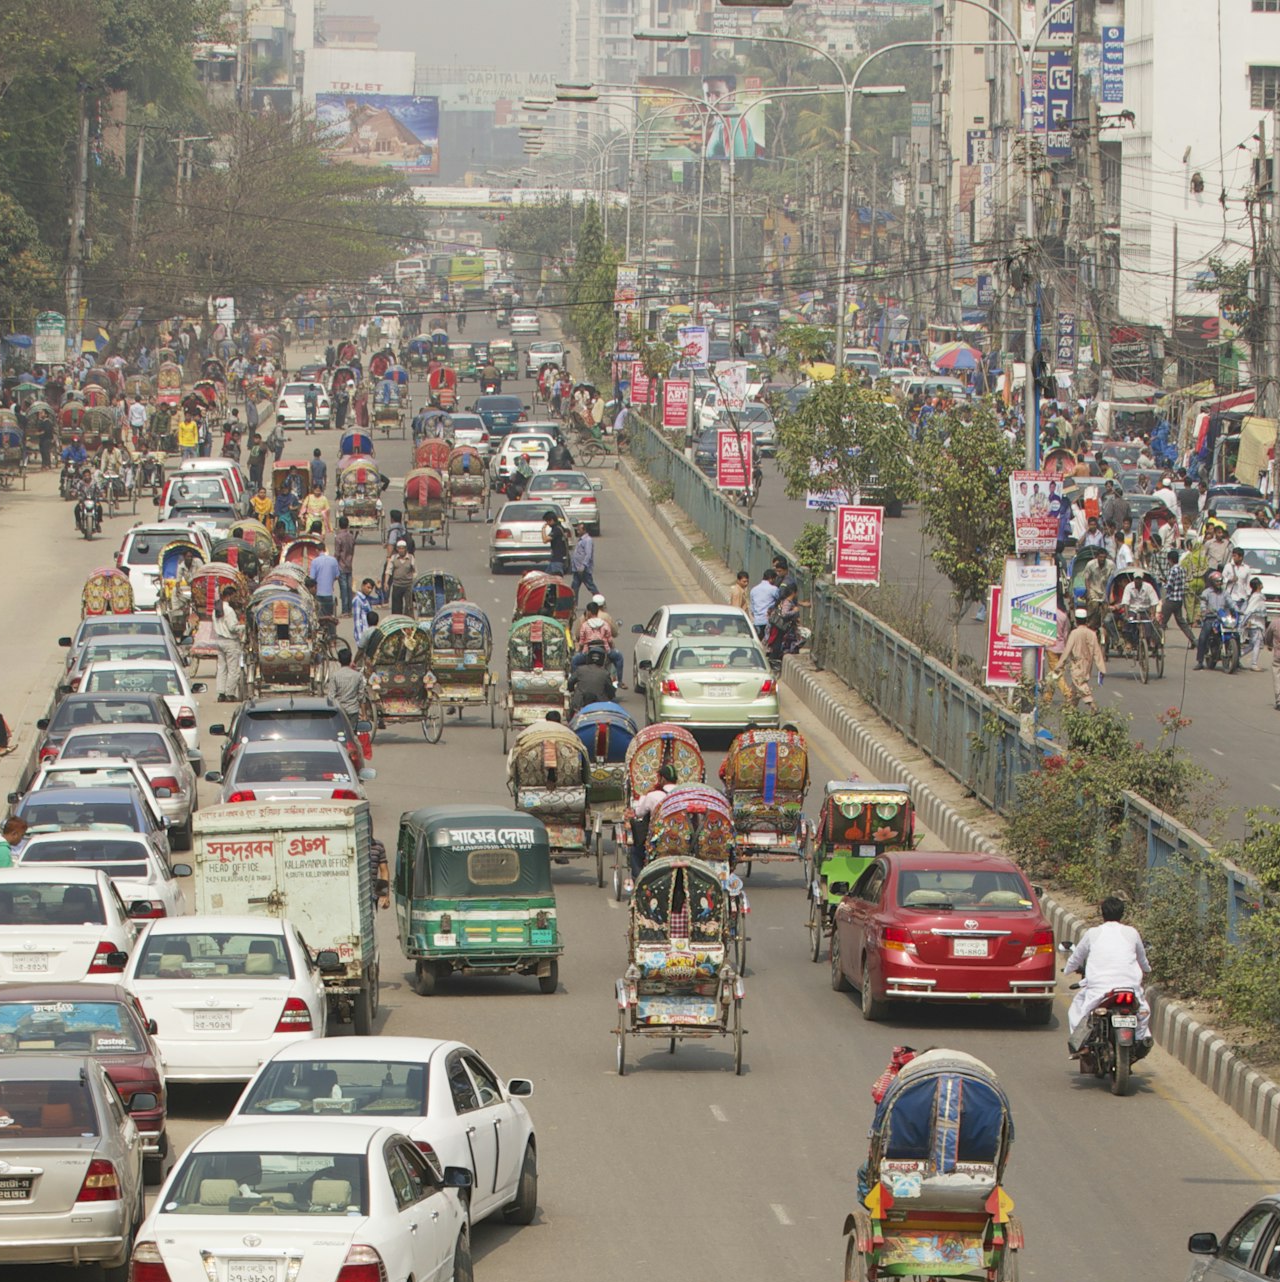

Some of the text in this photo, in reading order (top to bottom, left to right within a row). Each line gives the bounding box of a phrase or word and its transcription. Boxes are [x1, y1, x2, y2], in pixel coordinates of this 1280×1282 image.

[467, 73, 522, 84] CAPITAL
[330, 81, 384, 91] TO-LET
[844, 514, 875, 523] DHAKA
[844, 523, 876, 535] ART
[844, 534, 875, 542] SUMMIT
[449, 829, 536, 845] মায়ের দোয়া
[207, 836, 330, 863] সুন্দরবন গ্রুপ
[209, 861, 259, 873] HEAD OFFICE
[329, 857, 350, 868] OFFICE
[97, 1038, 127, 1046] Castrol
